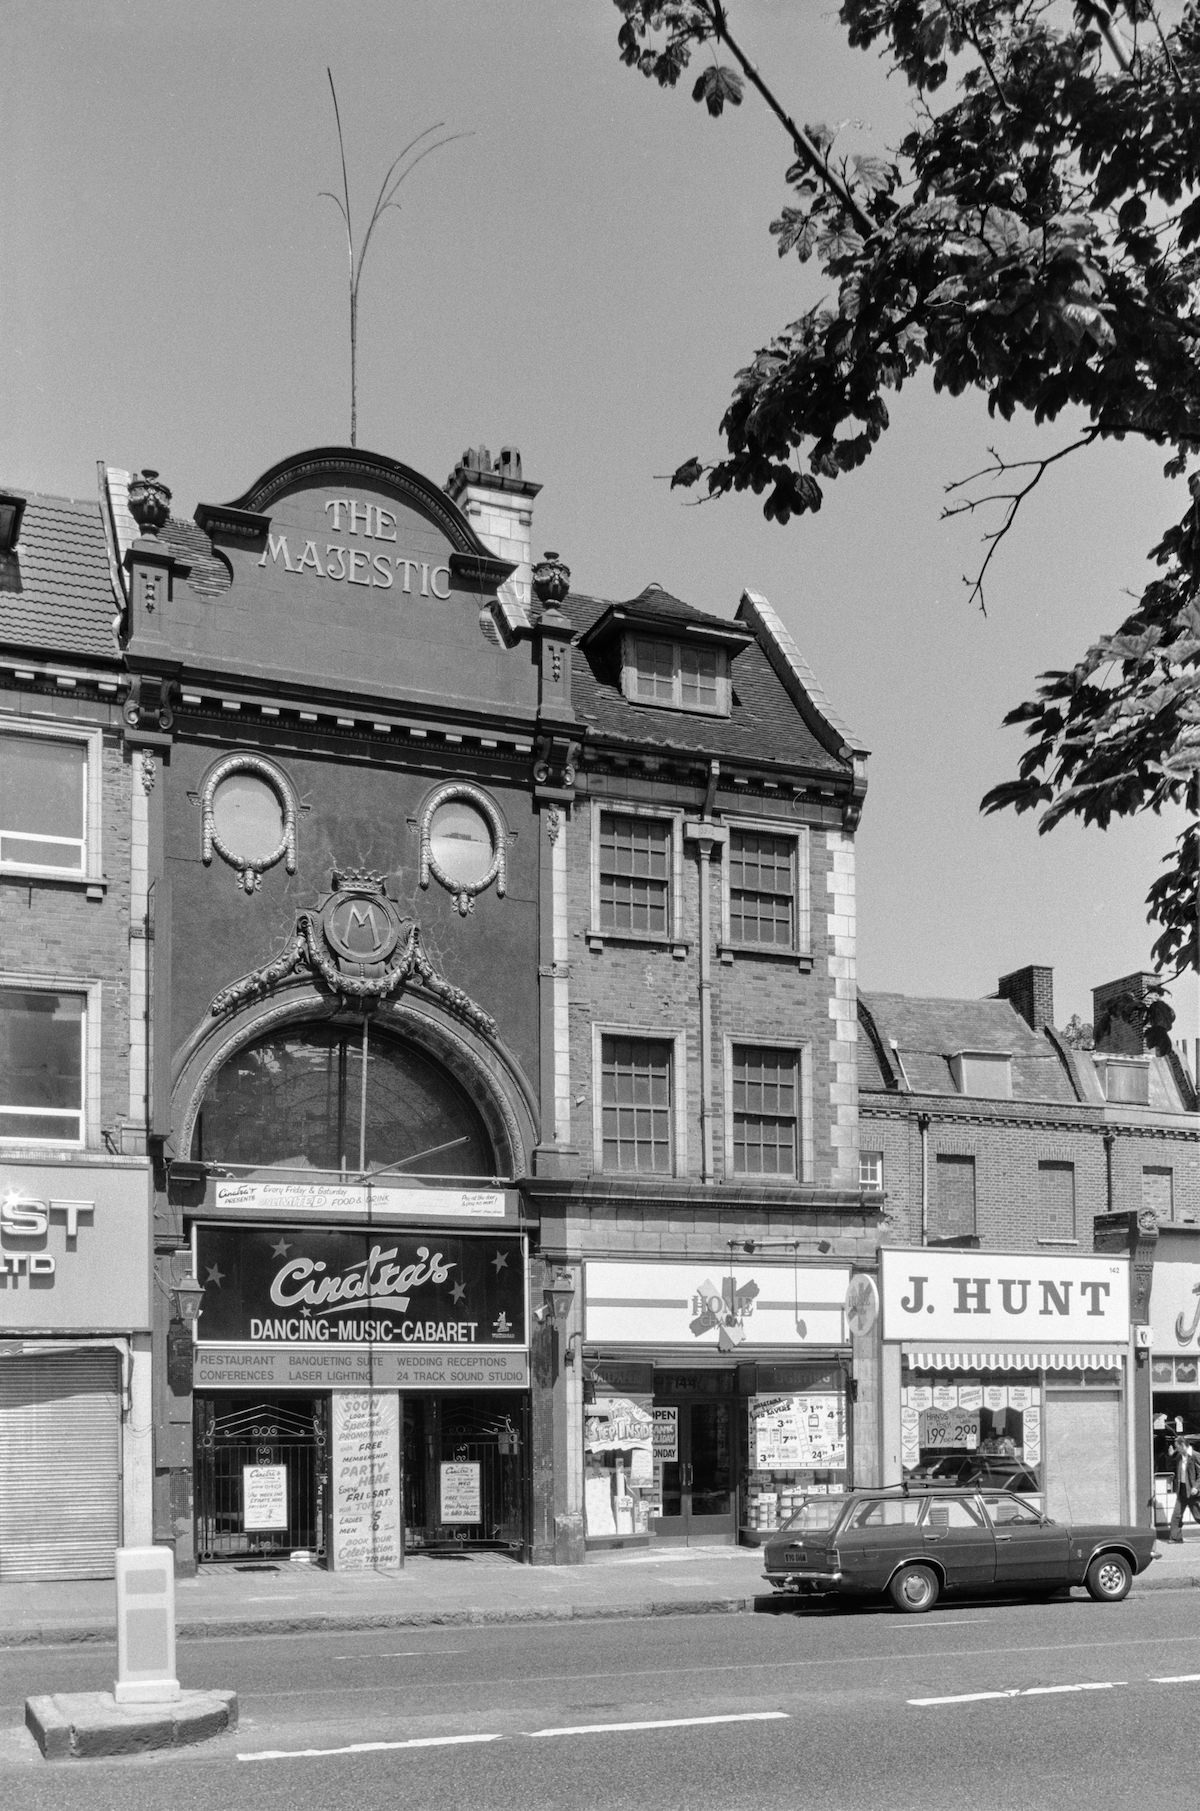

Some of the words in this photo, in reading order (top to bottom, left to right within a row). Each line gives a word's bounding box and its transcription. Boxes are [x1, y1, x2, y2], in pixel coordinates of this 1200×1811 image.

[325, 500, 397, 542] THE
[258, 534, 452, 600] MAJESTIC
[340, 904, 381, 951] M
[263, 1185, 283, 1195] Every
[285, 1186, 307, 1195] Friday
[317, 1187, 348, 1195] Saturday
[332, 1198, 355, 1207] FOOD
[900, 1276, 935, 1315] J.
[953, 1277, 1110, 1316] HUNT
[692, 1296, 753, 1317] HOME
[200, 1355, 275, 1366] RESTAURANT
[288, 1356, 351, 1368] BANQUETING
[356, 1356, 383, 1367] SUITE
[396, 1357, 444, 1367] WEDDING
[447, 1357, 507, 1368] RECEPTIONS
[200, 1370, 274, 1381] CONFERENCES
[288, 1371, 324, 1381] LASER
[327, 1371, 373, 1381] LIGHTING
[396, 1371, 409, 1381] 24
[414, 1371, 446, 1381] TRACK
[450, 1371, 484, 1381] SOUND
[489, 1371, 523, 1381] STUDIO
[344, 1399, 380, 1412] SOON
[339, 1429, 389, 1441] PROMOTIONS
[359, 1441, 383, 1452] FREE
[342, 1453, 389, 1462] MEMBERSHIP
[653, 1449, 676, 1458] ONDAY
[340, 1462, 386, 1478] PARTY
[359, 1473, 390, 1487] HERE
[346, 1492, 364, 1502] FRI
[372, 1488, 390, 1498] SAT
[340, 1517, 362, 1525] LADIES
